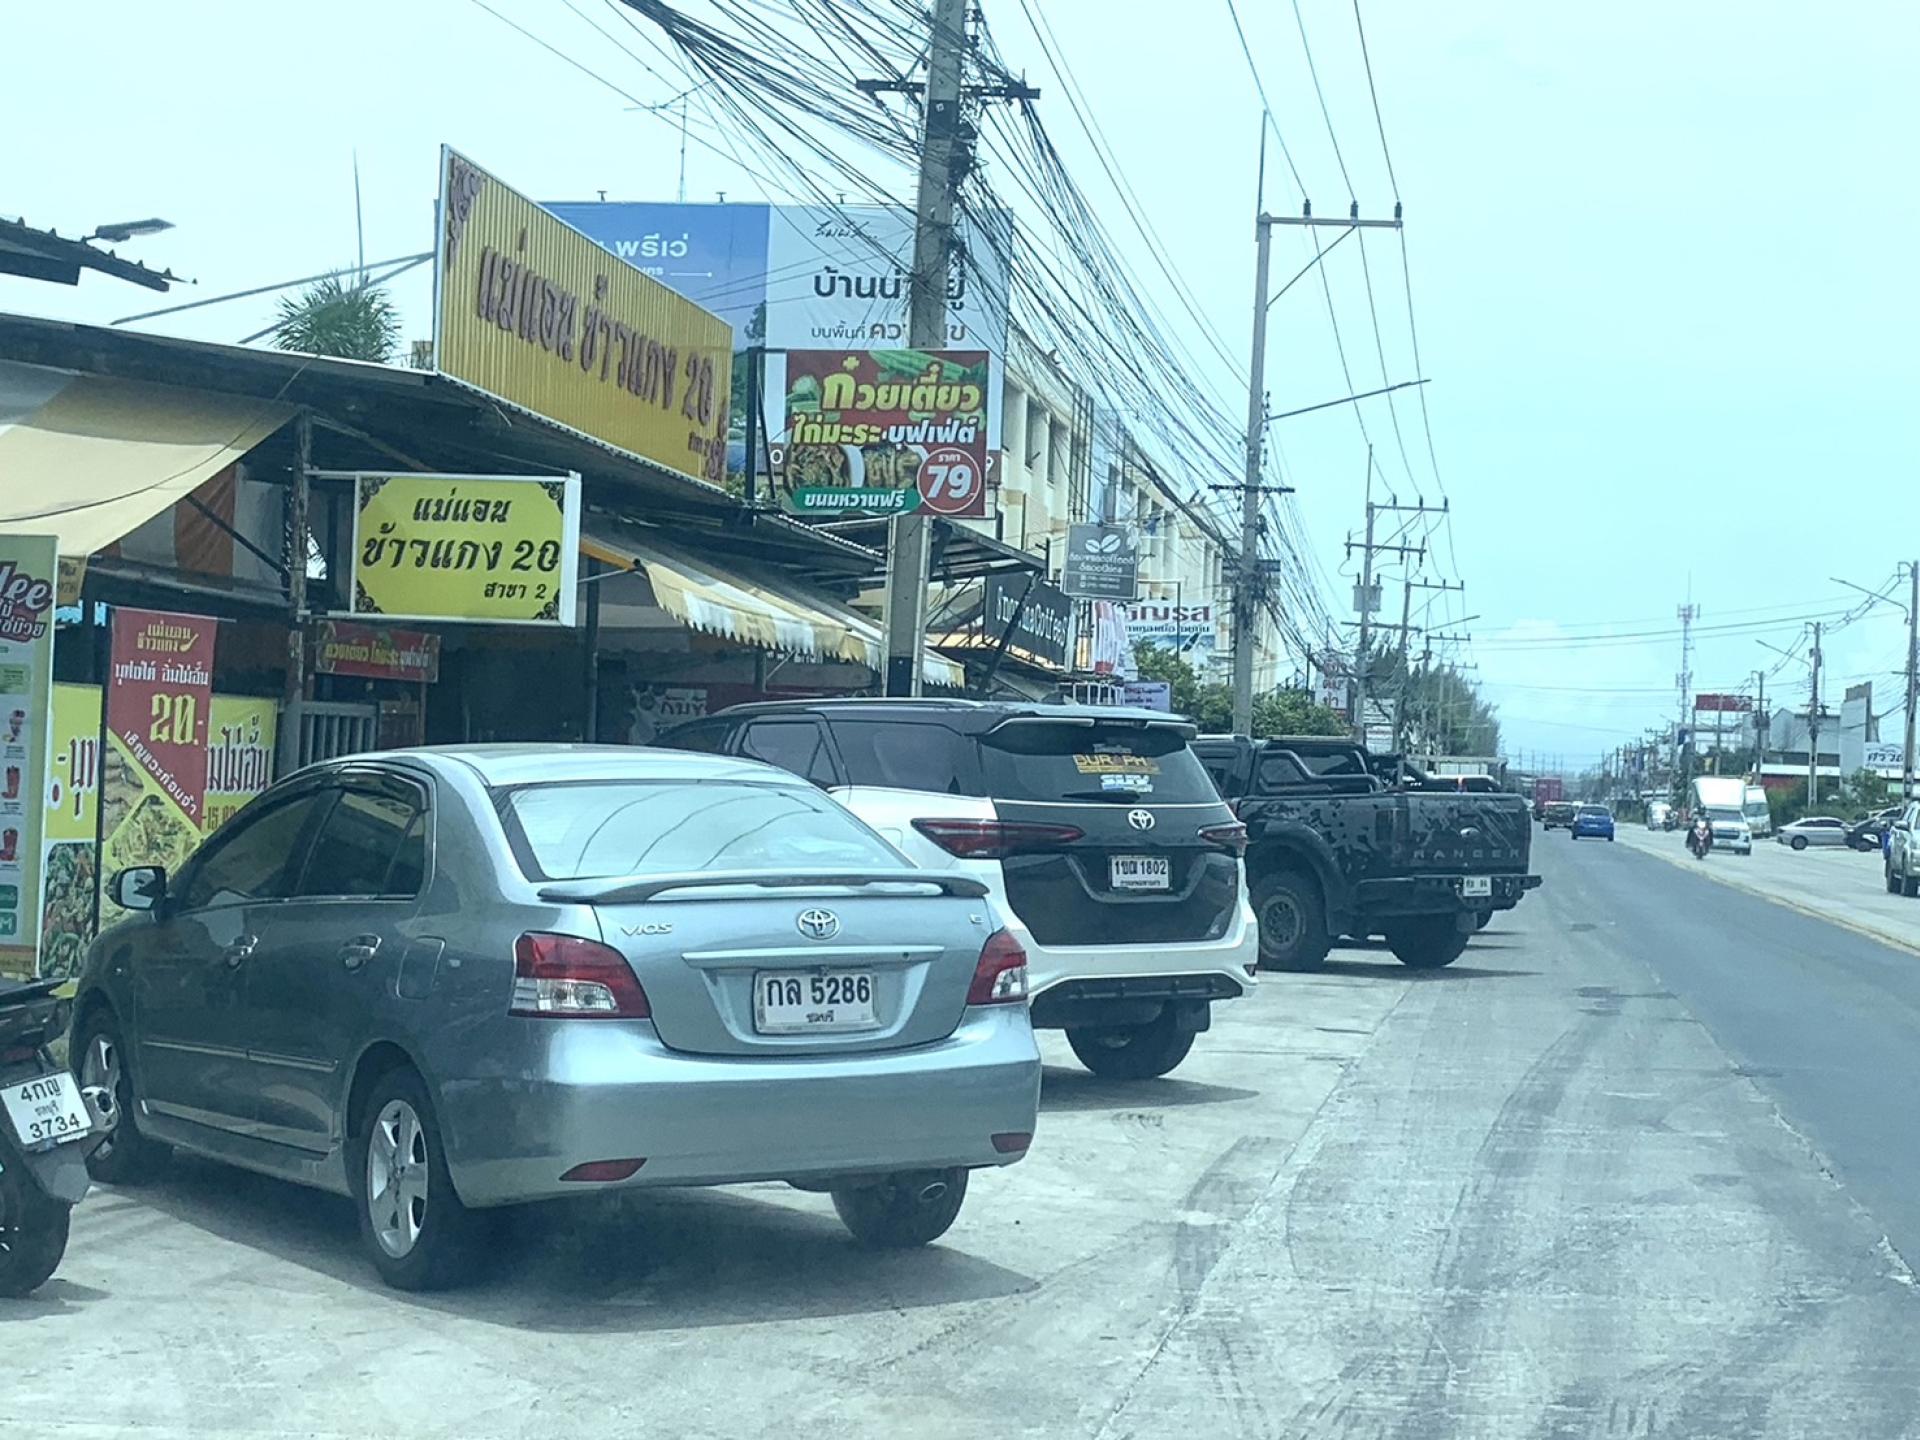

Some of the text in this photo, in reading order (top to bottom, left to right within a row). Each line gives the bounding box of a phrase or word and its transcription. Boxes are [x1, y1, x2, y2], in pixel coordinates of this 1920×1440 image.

[580, 273, 677, 411] ข้าวแกง
[822, 355, 981, 412] ก๋วยเตี๋ยว
[792, 413, 882, 444] ไก่มะระ
[412, 487, 512, 523] แม่แอน
[804, 488, 905, 508] ขนมหวานฟรี
[361, 521, 561, 572] ข้าวแกง 20
[484, 582, 547, 600] สาขา 2
[1141, 860, 1167, 875] 1802
[620, 922, 673, 937] VIOS
[766, 976, 871, 1007] กล 5286
[29, 1112, 81, 1139] 3734
